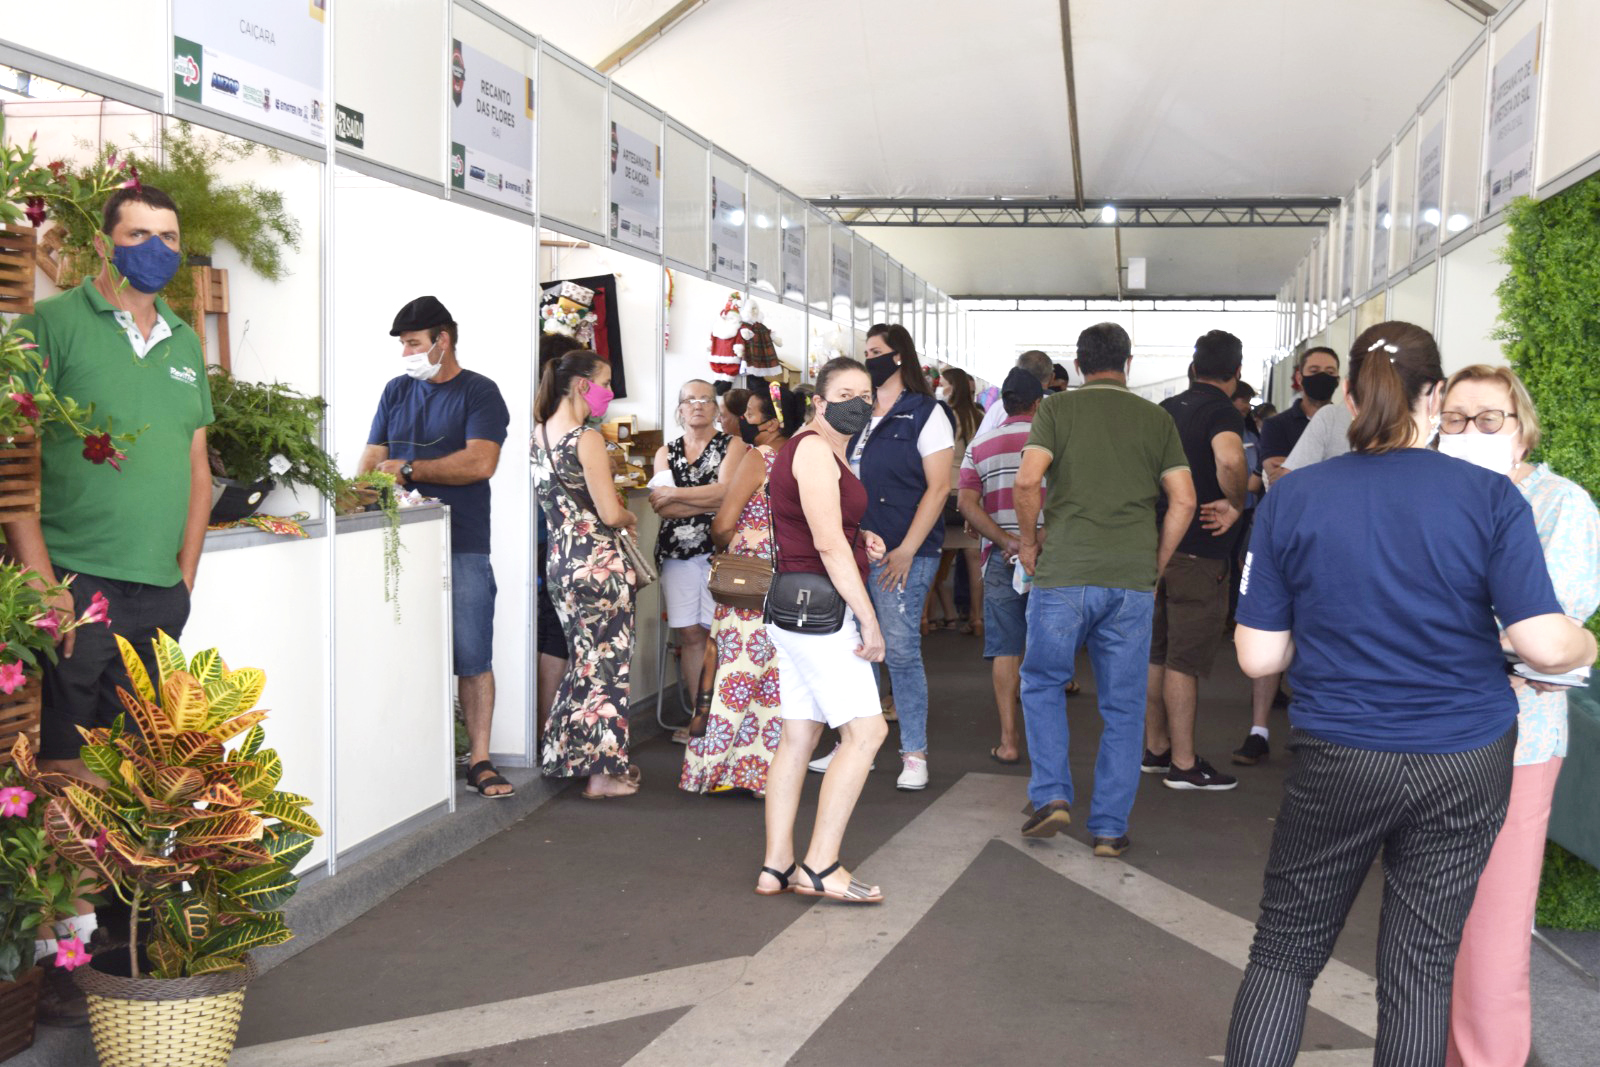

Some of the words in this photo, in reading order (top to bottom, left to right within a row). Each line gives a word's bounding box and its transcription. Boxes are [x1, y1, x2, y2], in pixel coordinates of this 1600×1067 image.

[239, 19, 276, 45] CAIÇARA
[480, 79, 511, 106] RECANTO
[476, 98, 490, 117] DAS
[491, 105, 515, 128] FLORES
[346, 115, 364, 141] SAÍDA
